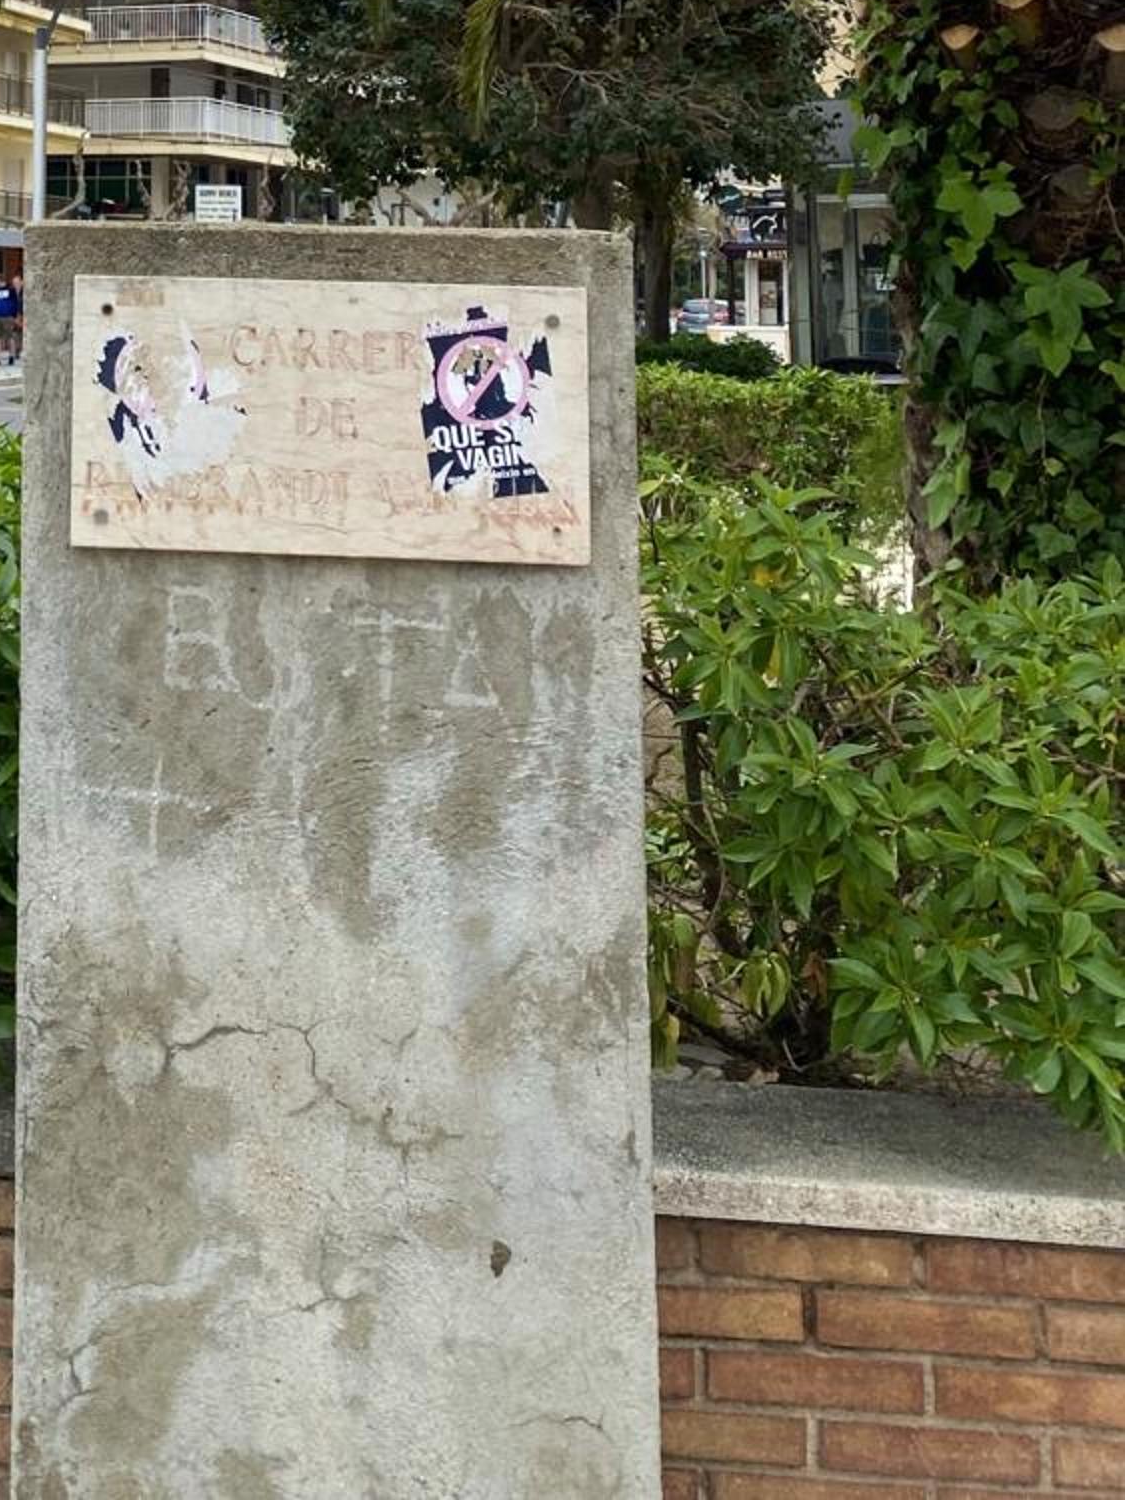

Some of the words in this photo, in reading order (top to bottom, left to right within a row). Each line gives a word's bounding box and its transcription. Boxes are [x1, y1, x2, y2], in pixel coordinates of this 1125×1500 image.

[232, 325, 421, 373] CARRER
[296, 396, 358, 438] DE
[434, 424, 485, 453] QUE
